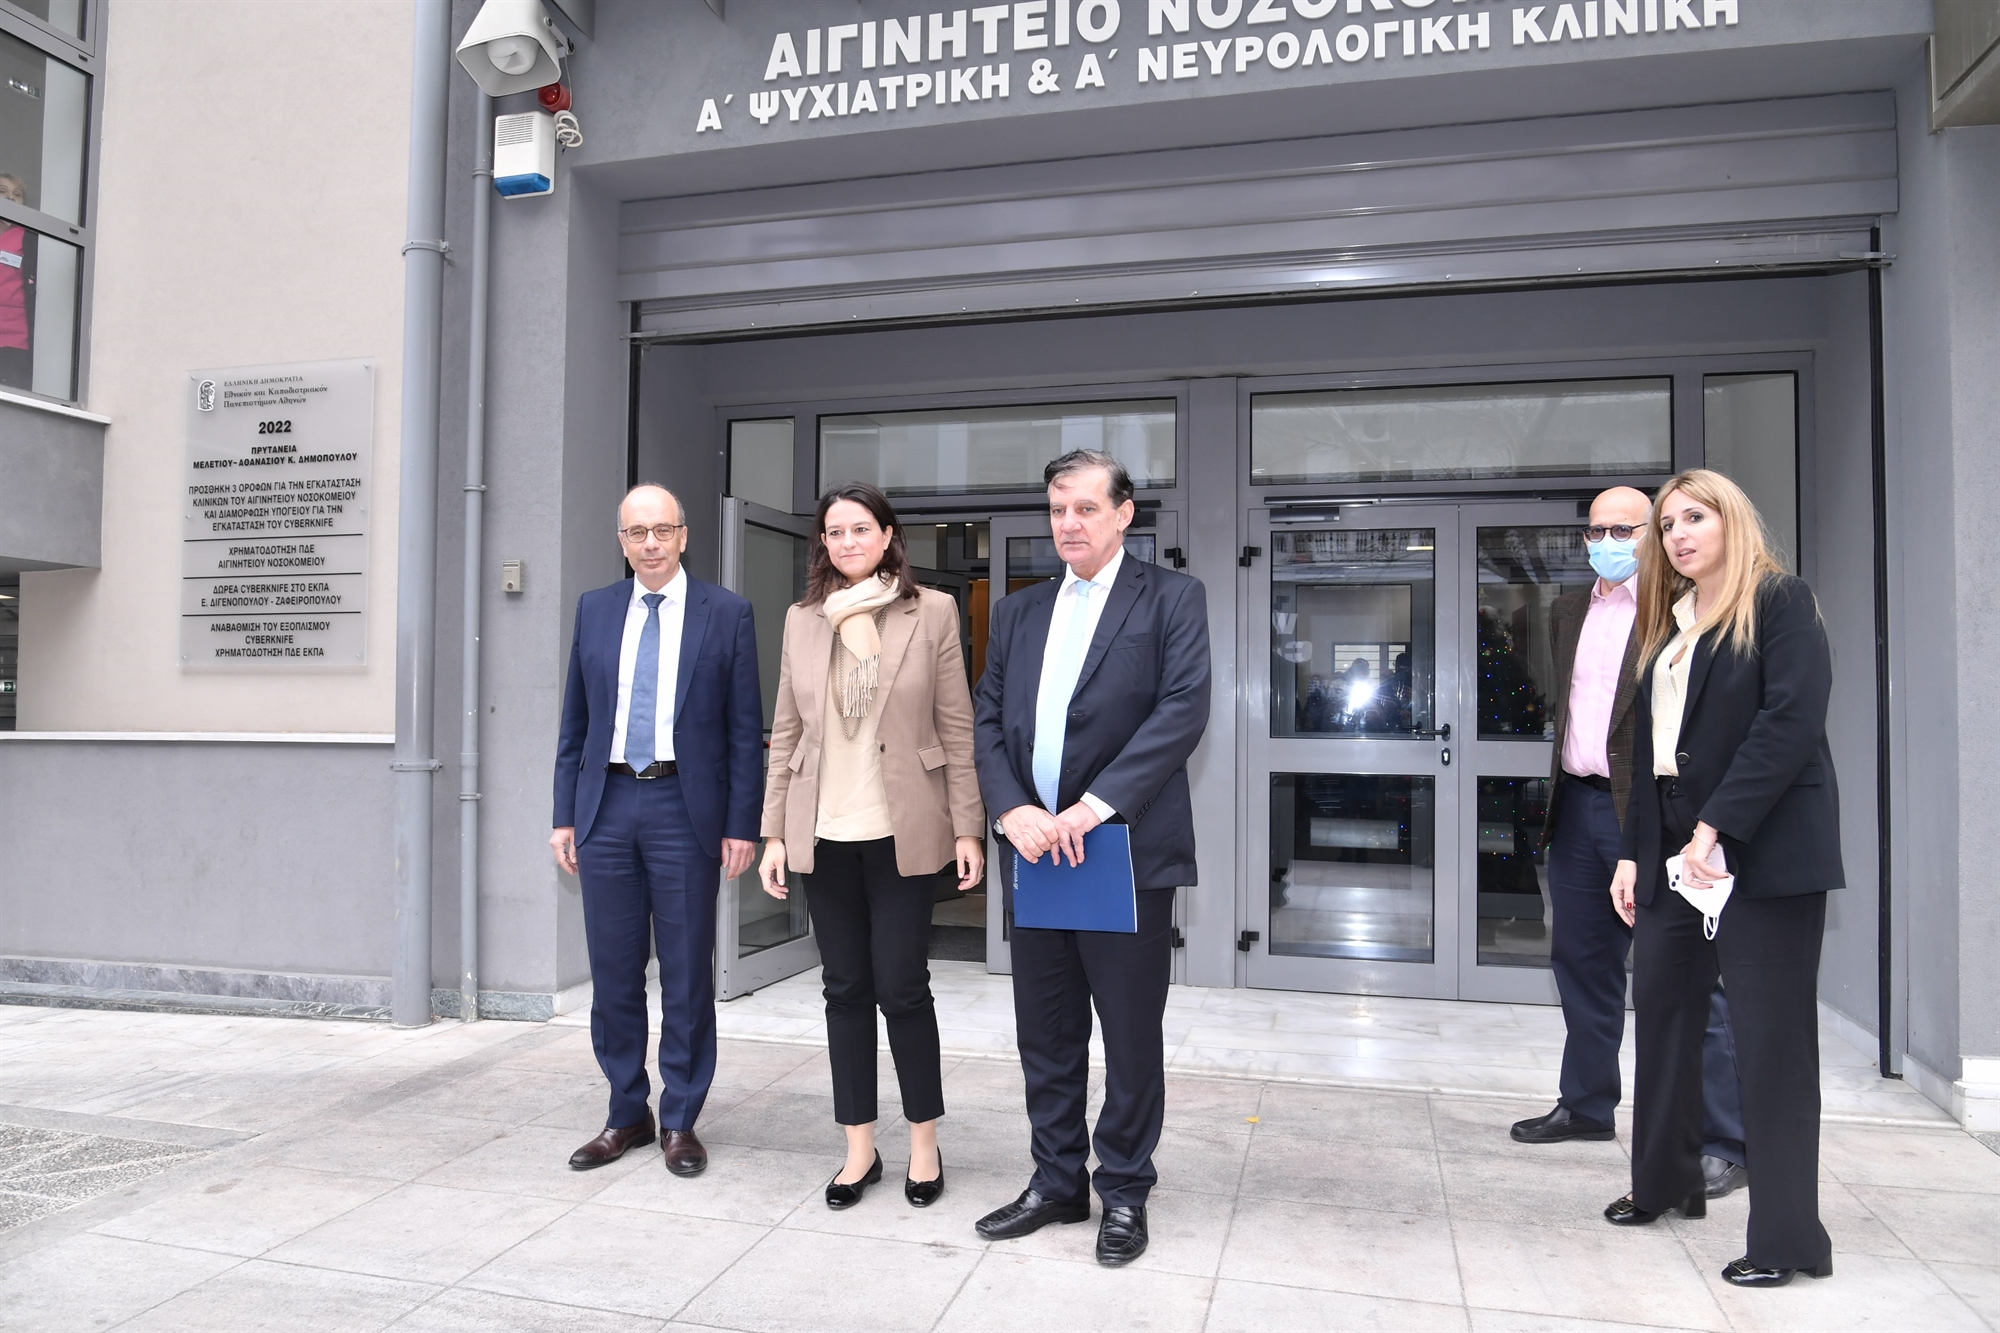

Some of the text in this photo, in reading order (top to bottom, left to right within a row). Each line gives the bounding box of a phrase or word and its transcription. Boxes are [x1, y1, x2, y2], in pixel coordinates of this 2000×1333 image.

[764, 0, 1121, 81] ΑΙΓΙΝΗΤΕΙΟ
[748, 62, 1011, 125] ΨΥΧΙΑΤΡΙΚΗ
[1027, 58, 1061, 95] &
[1138, 11, 1490, 83] ΝΕΥΡΟΛΟΓΙΚΗ
[1512, 0, 1739, 45] ΚΛΙΝΙΚΗ
[224, 375, 304, 387] ΕΛΛΗΝΙΚΗ ΔΗΜΟΚΡΑΤΙΑ
[258, 420, 292, 435] 2022
[251, 444, 297, 455] ΠΡΥΤΑΝΕΙΑ
[288, 455, 296, 464] Κ.
[298, 452, 358, 464] ΔΗΜΟΠΟΥΛΟΥ
[188, 477, 361, 495] ΠΡΟΣΘΗΚΗ 3 ΟΡΟΦΩΝ ΓΙΑ ΤΗΝ ΕΓΚΑΤΑΣΤΑΣΗ
[193, 491, 357, 507] ΚΛΙΝΙΚΩΝ ΤΟΥ ΑΙΓΙΝΗΤΕΙΟΥ ΝΟΣΟΚΟΜΕΙΟΥ
[204, 504, 343, 519] ΚΑΙ ΔΙΑΜΟΡΦΩΣΗ ΥΠΟΓΕΙΟΥ ΓΙΑ ΤΗΝ
[212, 518, 333, 532] ΕΓΚΑΤΑΣΤΑΣΗ ΤΟΥ CYBERKNIFE
[228, 544, 315, 556] ΧΡΗΜΑΤΟΔΟΤΗΣΗ ΠΔΕ
[218, 556, 326, 569] ΑΙΓΙΝΗΤΕΙΟΥ ΝΟΣΟΚΟΜΕΙΟΥ
[212, 582, 330, 595] ΔΩΡΕΑ CYBERKNIFE ΣΤΟ ΕΚΠΑ
[201, 598, 208, 607] Ε.
[210, 596, 269, 607] ΔΙΓΕΝΟΠΟΥΛΟΥ
[275, 595, 342, 606] ΖΑΦΕΙΡΟΠΟΥΛΟΥ
[210, 621, 331, 632] ΑΝΑΒΑΘΜΙΣΗ ΤΟΥ ΕΞΟΠΛΙΣΜΟΥ
[245, 635, 294, 645] CYBERKNIFE
[215, 647, 325, 658] ΧΡΗΜΑΤΟΔΟΤΗΣΗ ΠΔΕ ΕΚΠΑ
